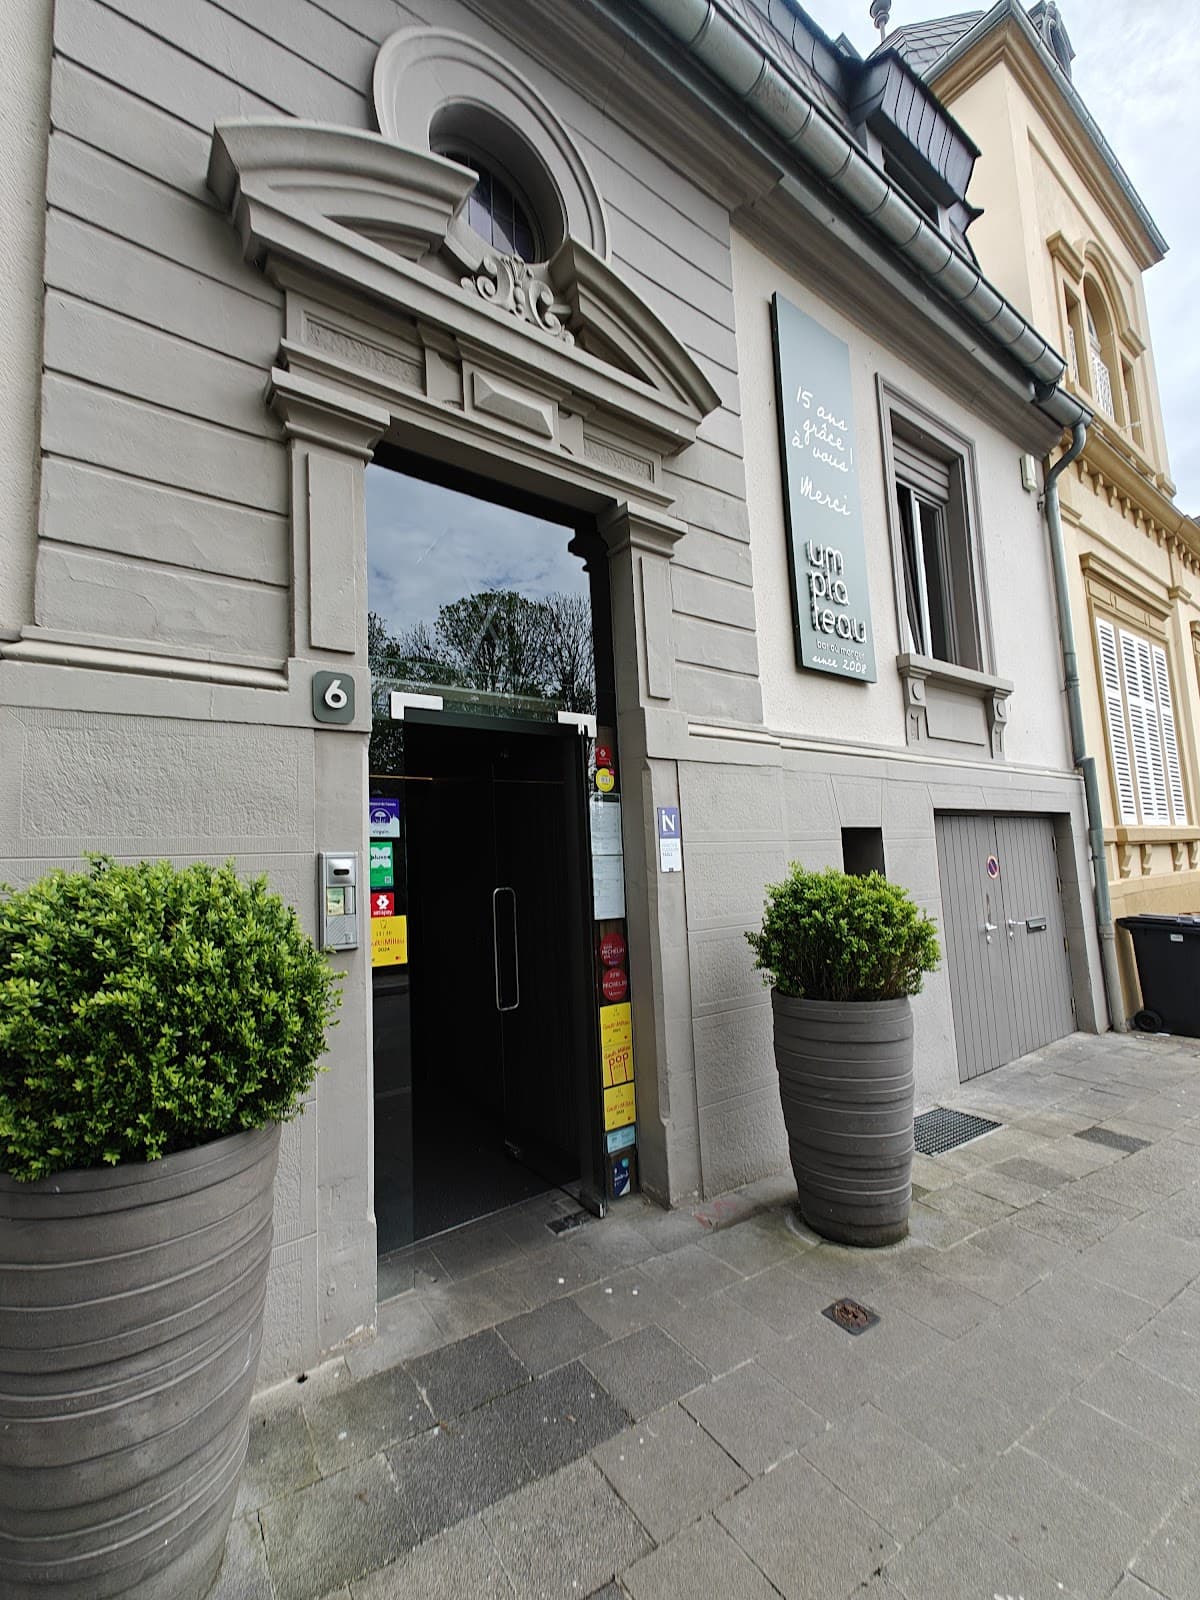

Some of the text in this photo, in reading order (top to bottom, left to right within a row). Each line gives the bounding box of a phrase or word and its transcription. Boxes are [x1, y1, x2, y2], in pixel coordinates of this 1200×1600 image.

[797, 386, 848, 431] 15 ans
[791, 430, 804, 448] à
[803, 419, 845, 451] grâce
[800, 475, 851, 516] Merci
[807, 539, 844, 575] um
[812, 655, 867, 675] since 2008
[324, 679, 348, 709] 6
